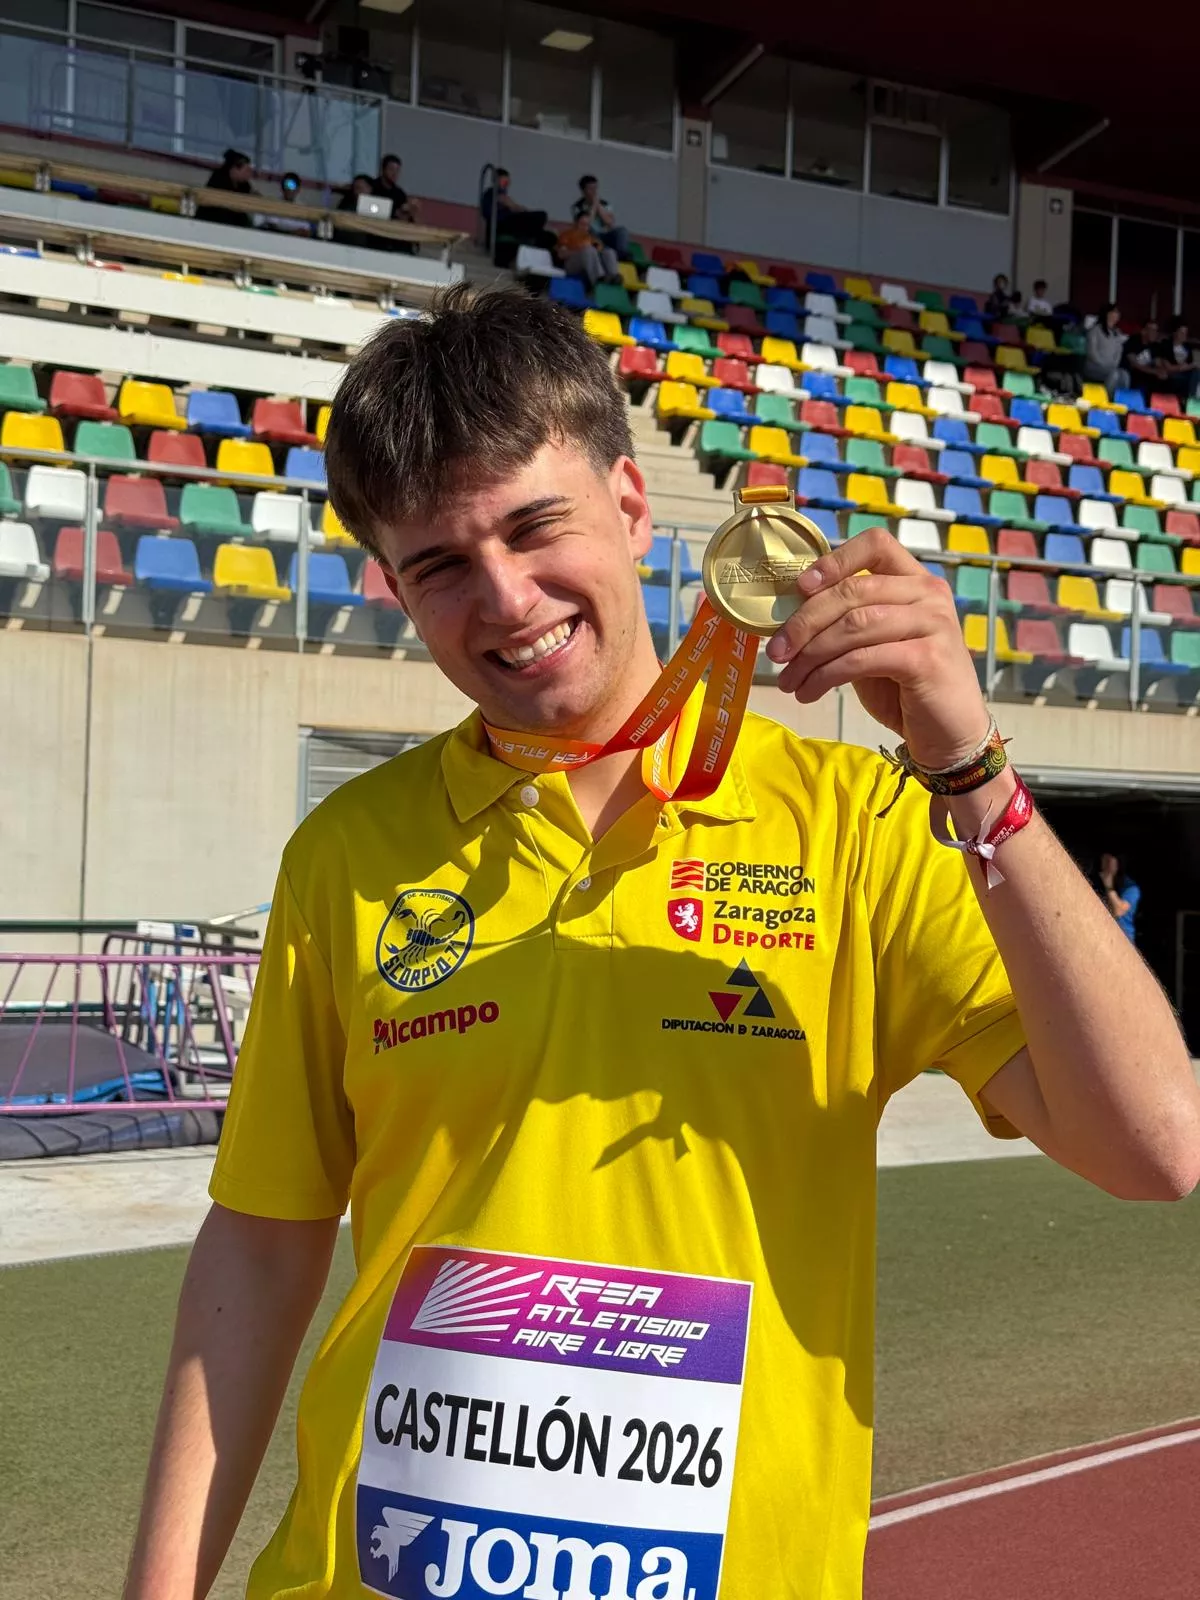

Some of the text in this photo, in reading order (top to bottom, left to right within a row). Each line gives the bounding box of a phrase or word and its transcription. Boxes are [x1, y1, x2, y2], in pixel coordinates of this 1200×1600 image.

[629, 667, 689, 745] ATLETISMO
[703, 664, 739, 774] ATLETISMO
[705, 877, 731, 892] DE
[706, 861, 804, 881] GOBIERNO
[419, 892, 454, 904] ATLETISMO
[713, 900, 816, 930] Zaragoza
[713, 923, 815, 951] DEPORTE
[373, 1001, 500, 1055] Alcampo
[661, 1018, 735, 1034] DIPUTACION
[752, 1025, 806, 1041] ZARAGOZA
[539, 1274, 664, 1308] RFEA
[527, 1304, 711, 1341] ATLETISMO
[512, 1328, 688, 1368] AIRE LIBRE
[374, 1383, 723, 1489] CASTELLÓN 2026
